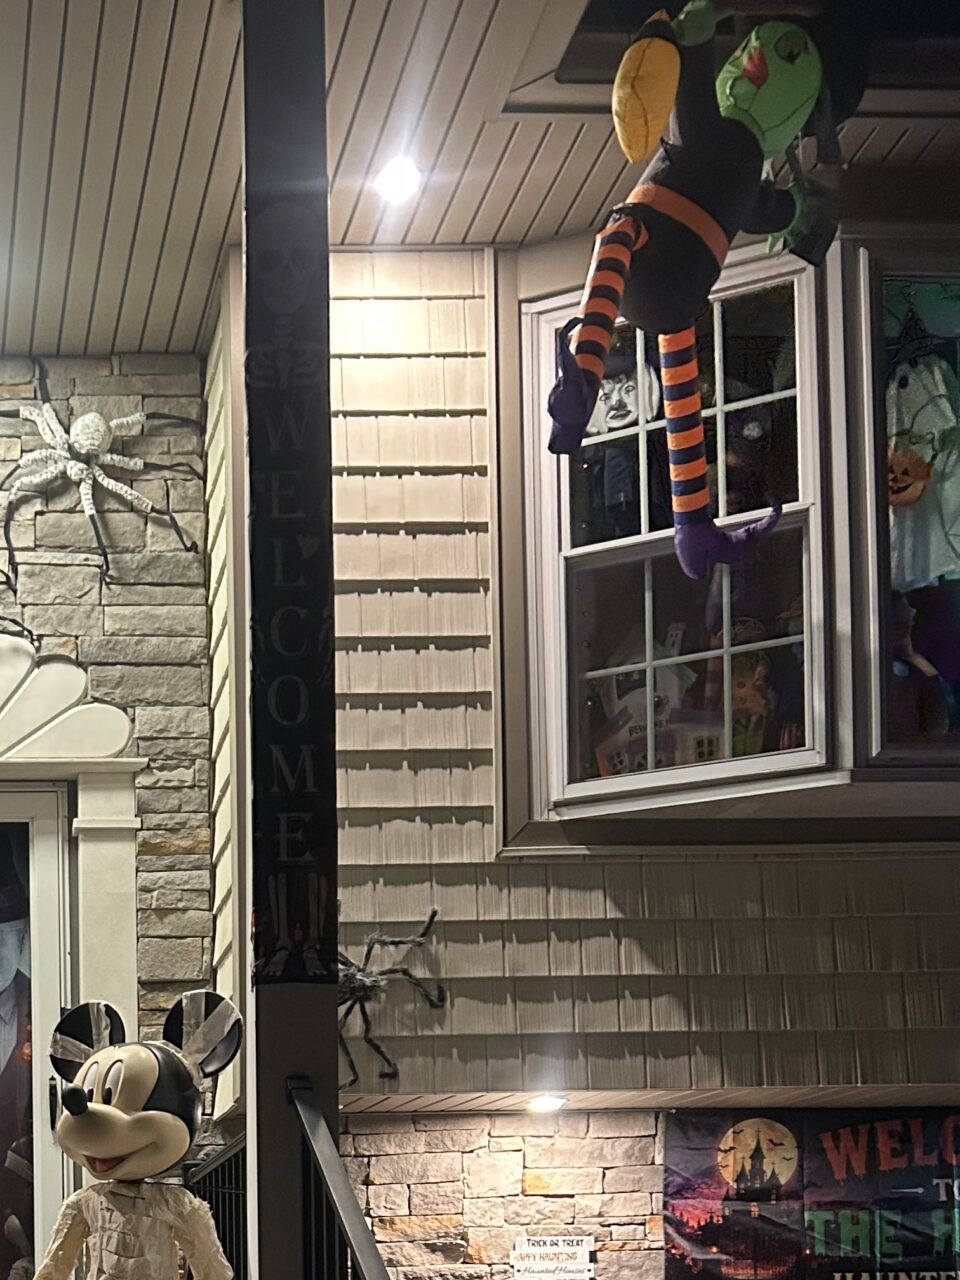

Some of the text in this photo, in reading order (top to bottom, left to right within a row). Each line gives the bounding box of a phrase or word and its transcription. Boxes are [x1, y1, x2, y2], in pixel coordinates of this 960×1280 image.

[262, 402, 319, 864] WELCOME
[527, 1239, 584, 1248] TRICK OR TREAT
[804, 1209, 902, 1258] THE
